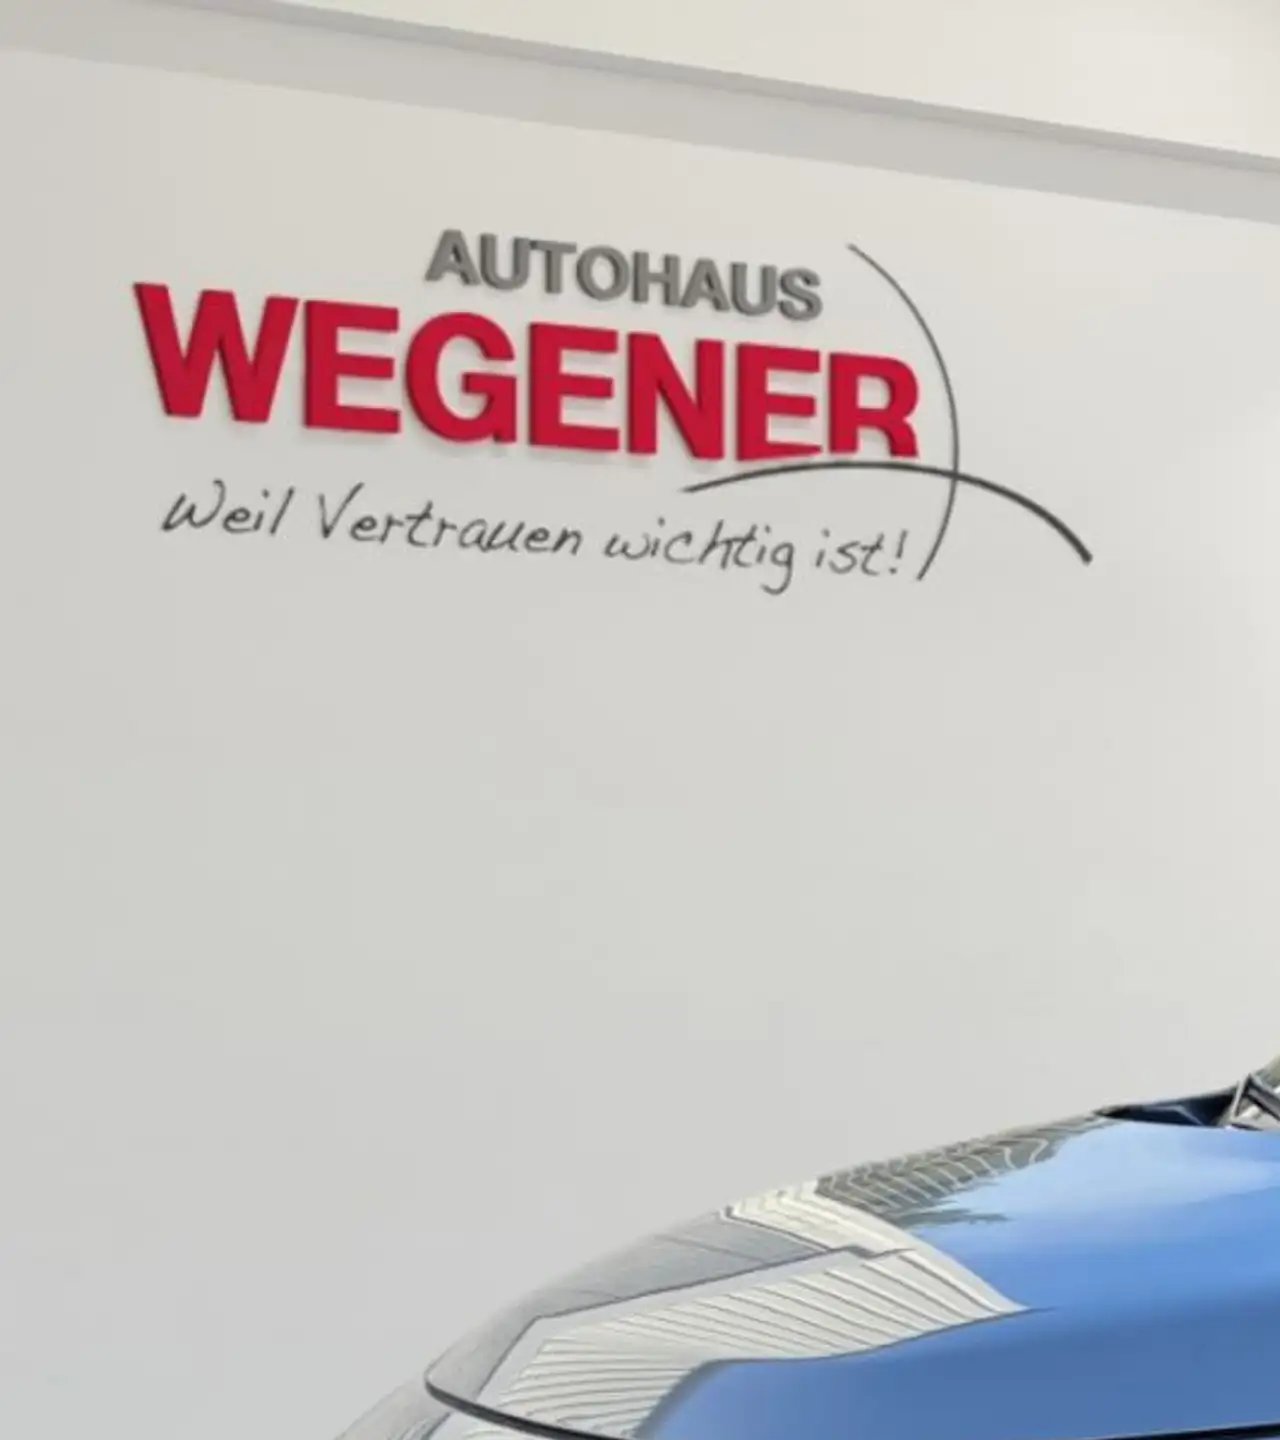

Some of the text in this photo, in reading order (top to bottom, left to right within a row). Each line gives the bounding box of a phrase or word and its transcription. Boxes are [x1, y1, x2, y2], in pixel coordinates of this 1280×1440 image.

[425, 228, 823, 321] AUTOHAUS
[132, 282, 920, 462] WEGENER
[162, 479, 906, 595] Weil Vertrauen wichtig ist!
